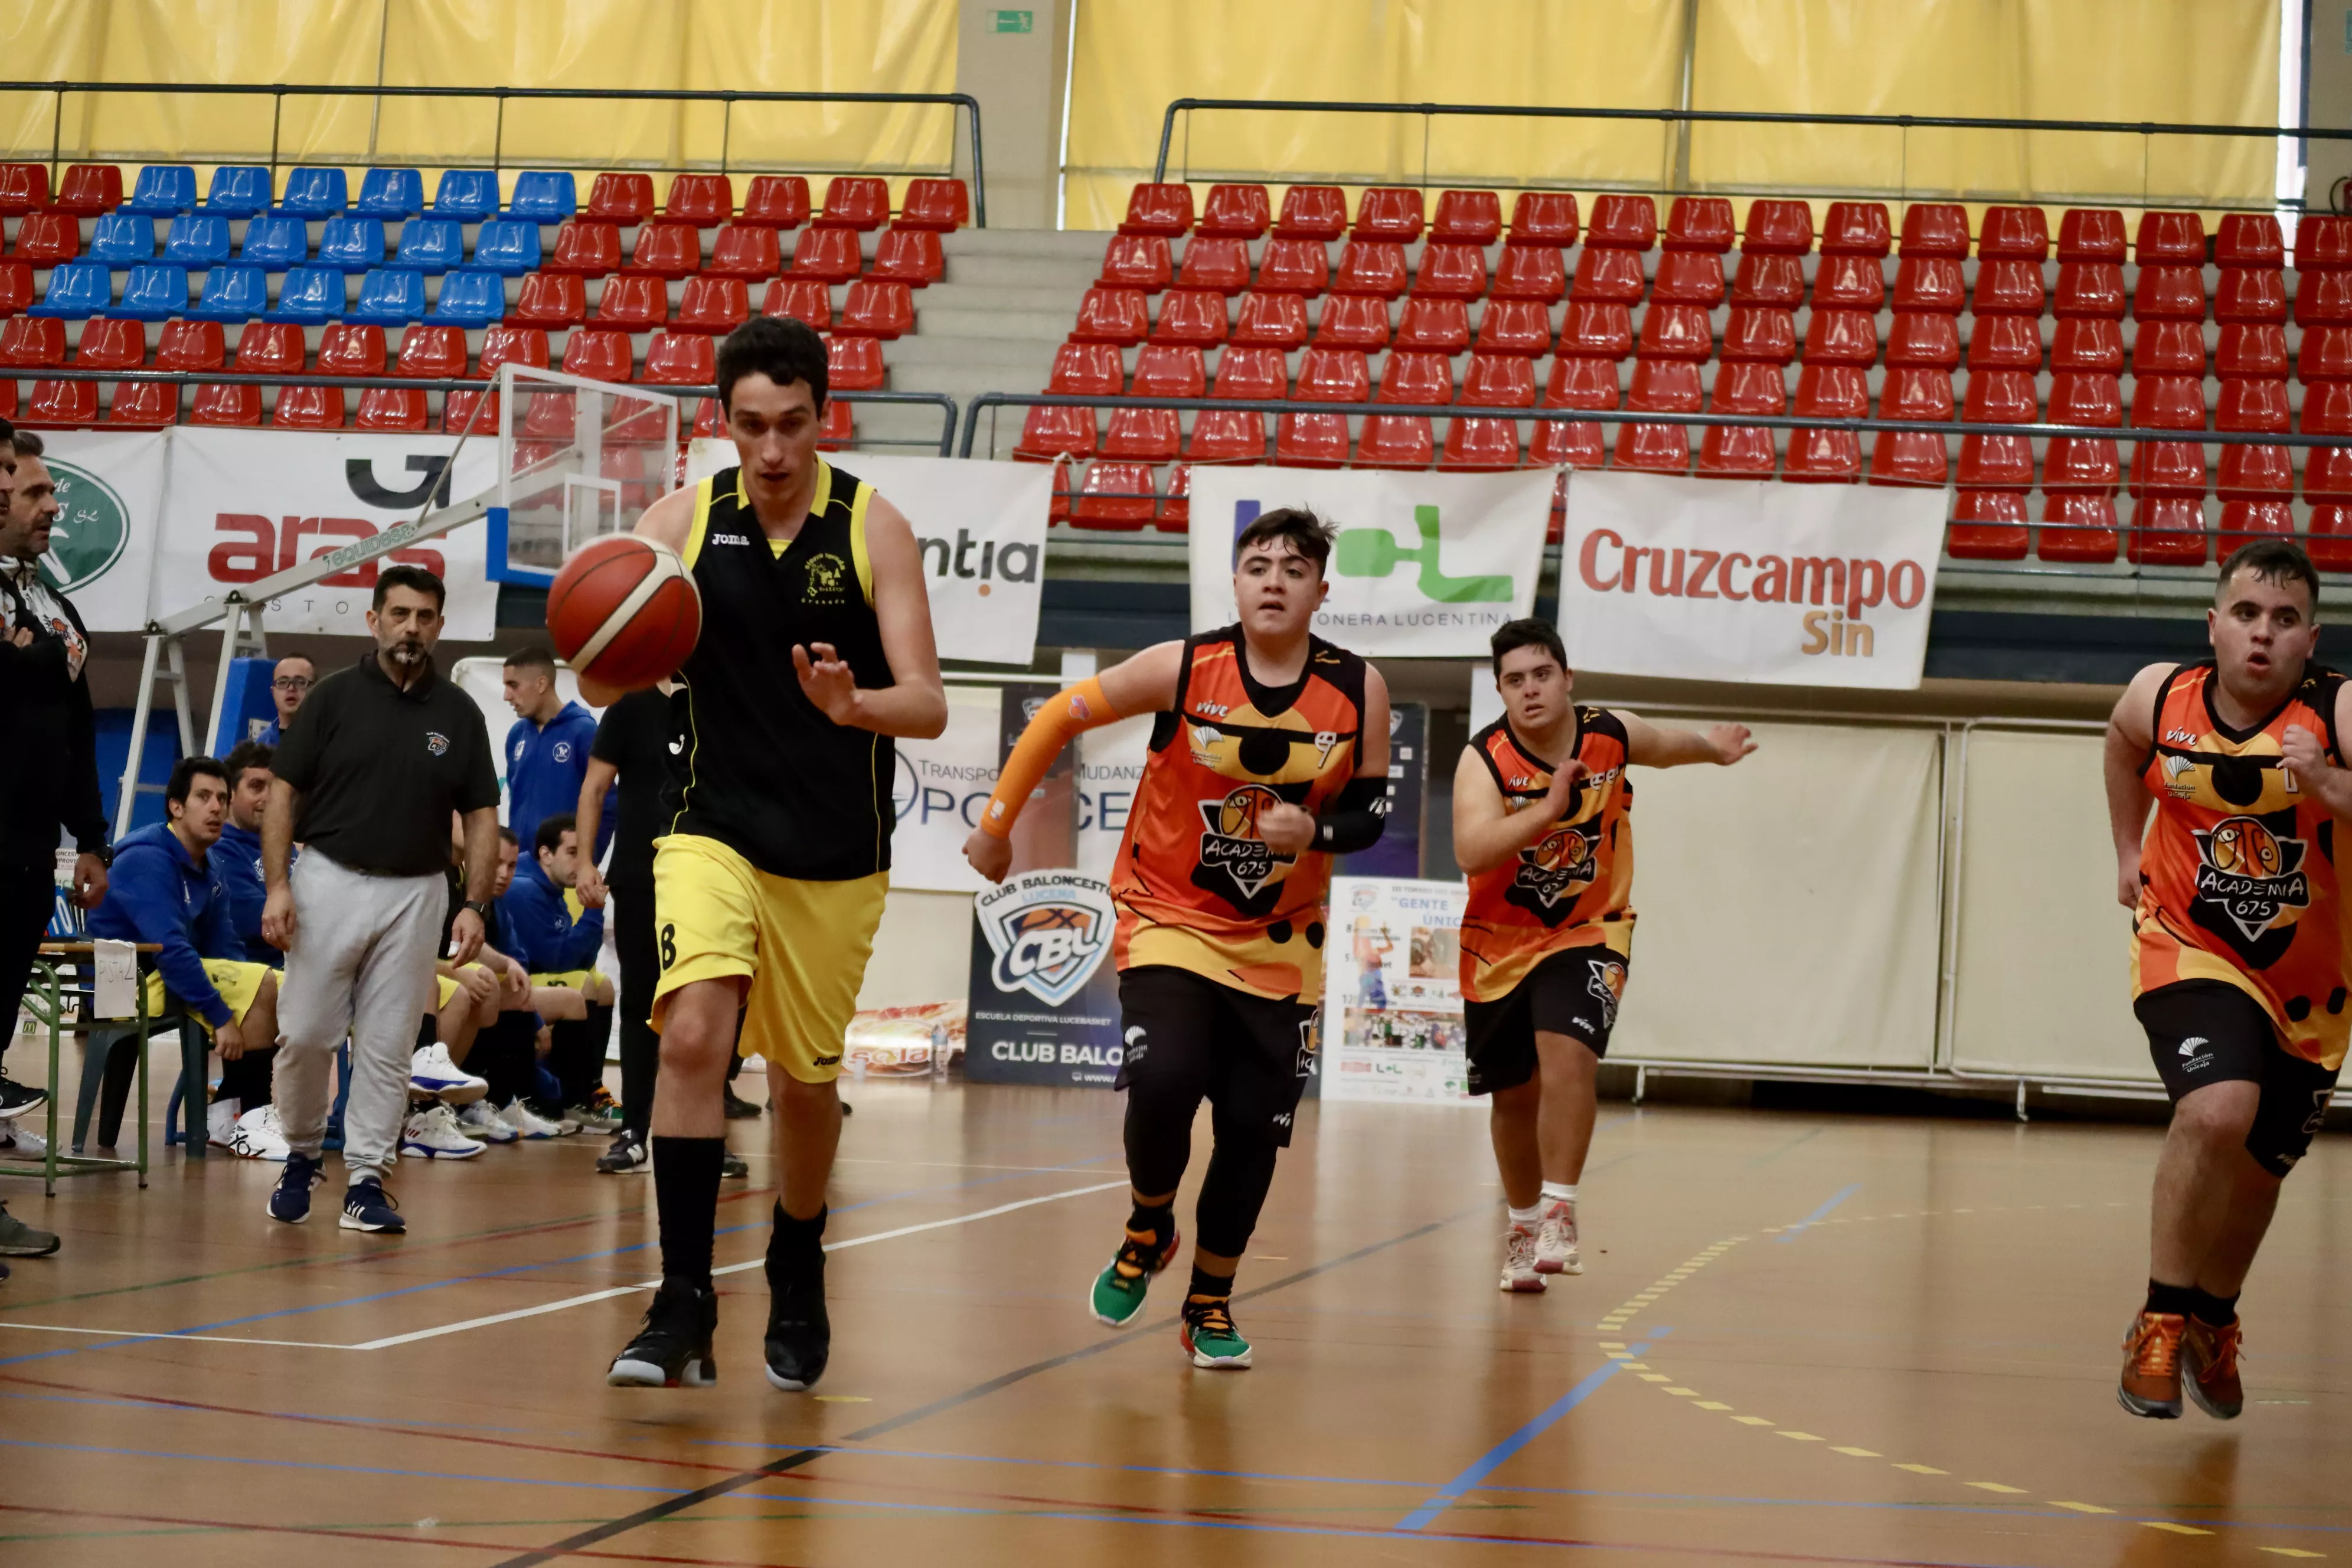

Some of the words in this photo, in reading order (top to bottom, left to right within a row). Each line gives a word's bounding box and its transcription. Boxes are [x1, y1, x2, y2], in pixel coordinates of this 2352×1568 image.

[1579, 529, 1926, 620] Cruzcampo
[1396, 612, 1513, 627] LUCENTINA
[1802, 610, 1874, 657] Sin
[1237, 861, 1268, 876] 675
[981, 883, 1017, 907] CLUB
[2200, 871, 2304, 897] ACADEMIA
[2236, 900, 2271, 916] 675
[975, 1012, 1011, 1021] ESCUELA
[1012, 1014, 1058, 1023] DEPORTIVA
[1059, 1016, 1112, 1026] LUCEBASKET
[991, 1040, 1056, 1063] CLUB
